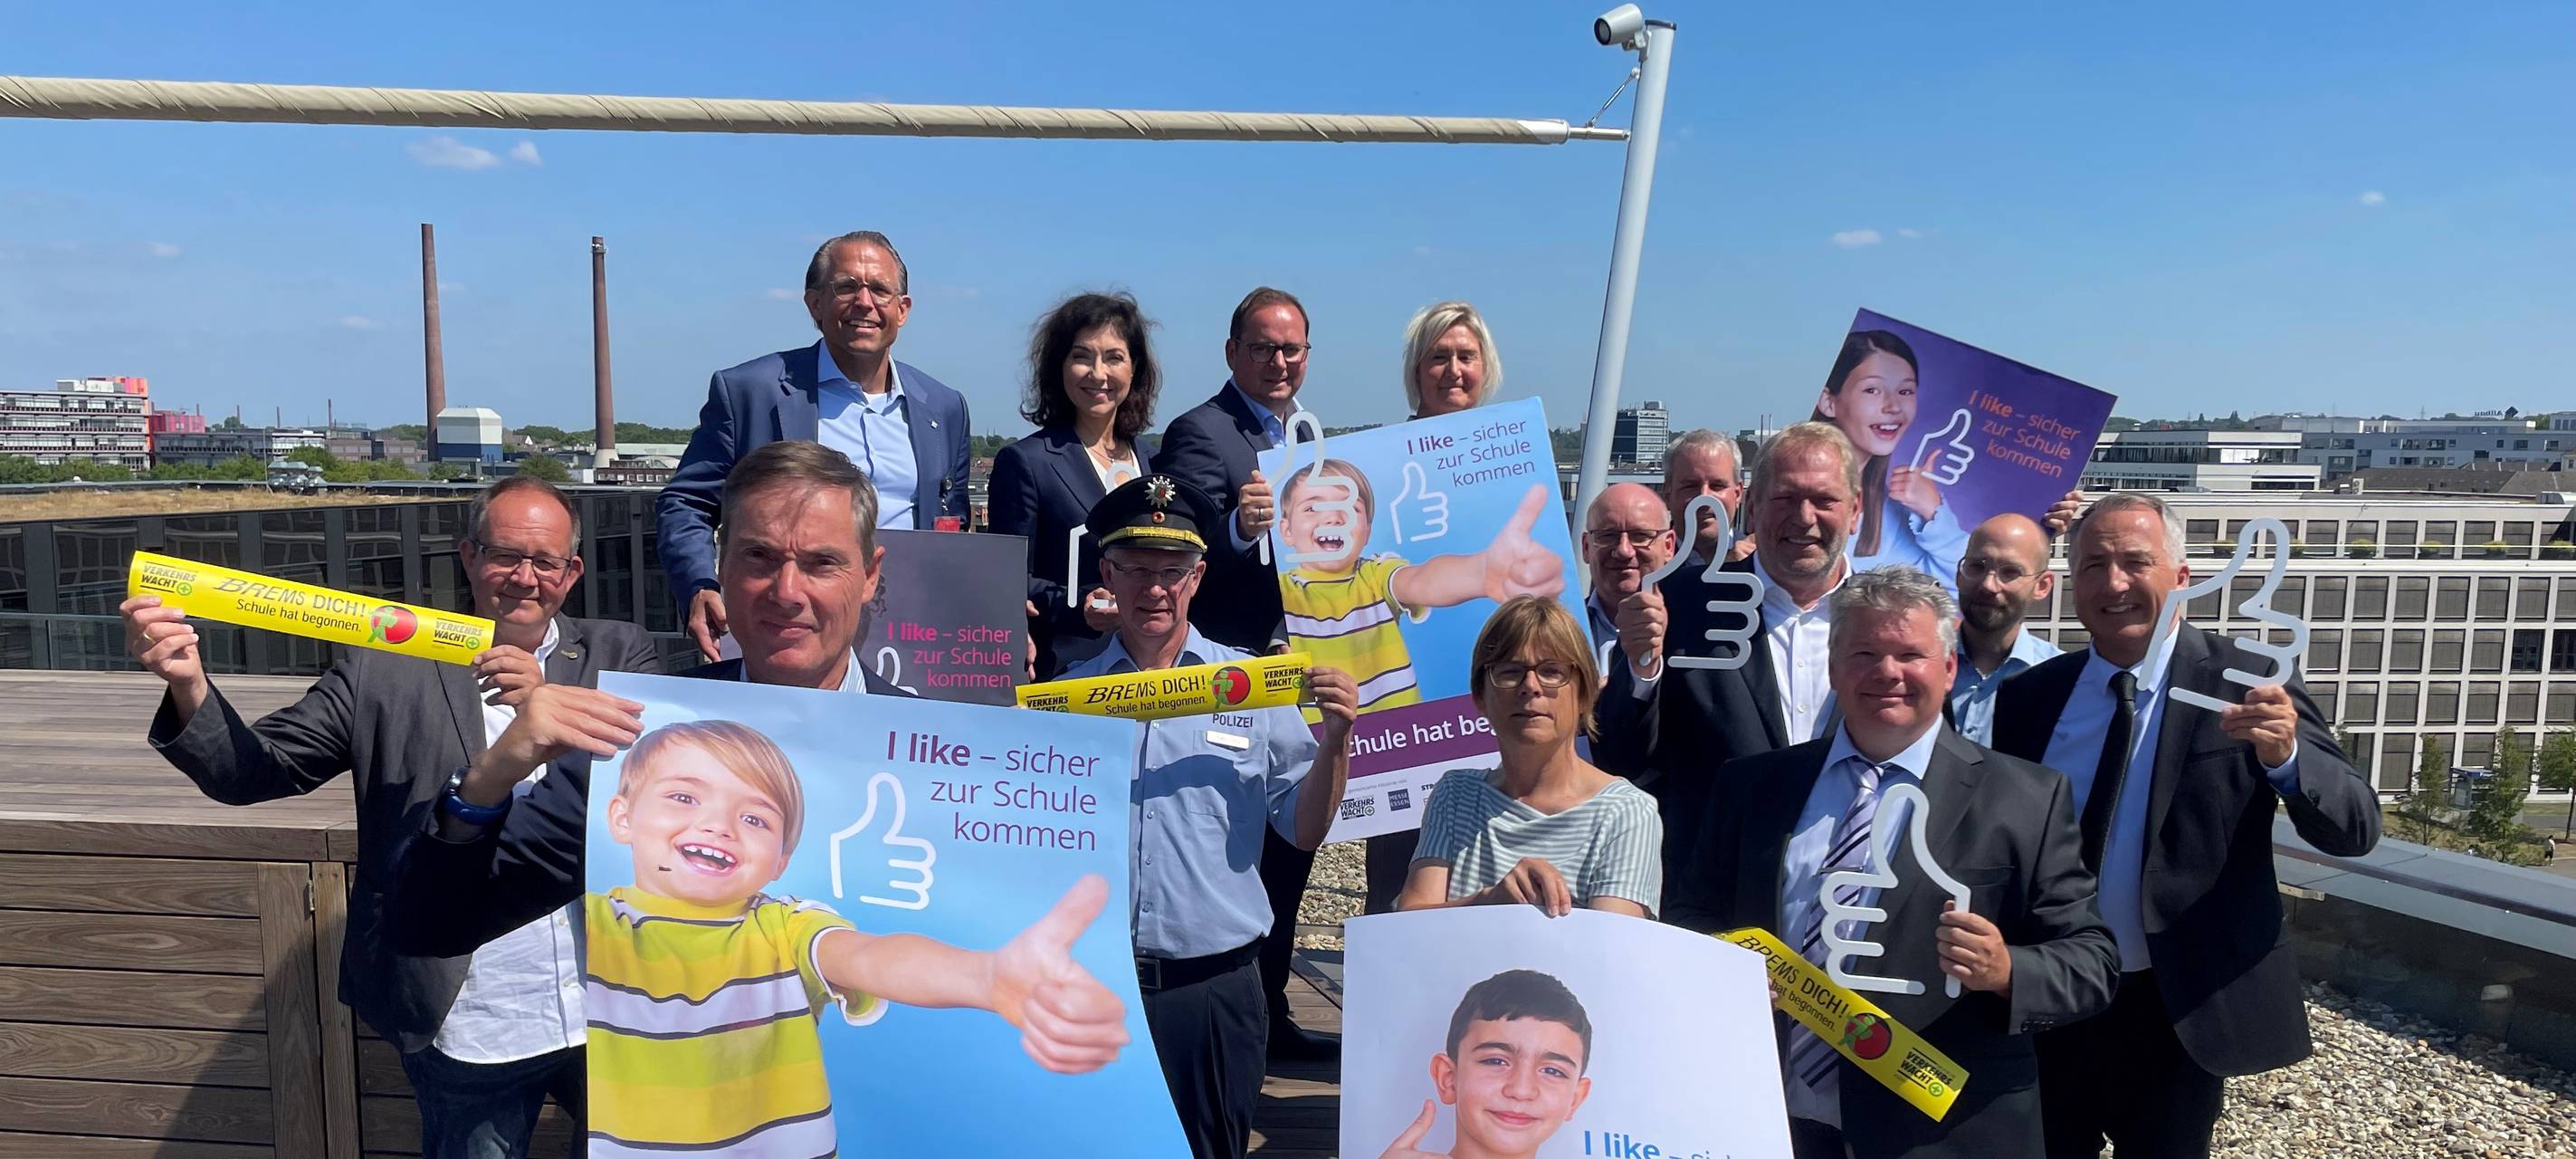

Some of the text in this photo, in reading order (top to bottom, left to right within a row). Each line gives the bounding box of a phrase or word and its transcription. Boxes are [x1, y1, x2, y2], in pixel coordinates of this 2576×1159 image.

[1969, 390, 1979, 405] I
[1980, 394, 2013, 417] like
[2027, 414, 2081, 441] sicher
[1407, 439, 1414, 455] I
[1419, 435, 1454, 452] like
[1473, 420, 1526, 442] sicher
[1982, 419, 2071, 460] zur Schule
[1436, 439, 1531, 470] zur Schule
[1986, 439, 2062, 478] kommen
[1453, 460, 1535, 487] kommen
[141, 574, 177, 588] WACHT
[144, 565, 196, 582] VERKEHRS
[213, 577, 366, 618] BREMS DICH!
[236, 599, 362, 632] Schule hat begonnen.
[435, 620, 483, 636] VERKEHRS
[434, 630, 467, 643] WACHT
[887, 622, 893, 639] I
[900, 623, 937, 641] like
[957, 625, 1012, 643] sicher
[913, 647, 1011, 666] zur Schule
[927, 669, 1011, 687] kommen
[1264, 666, 1303, 679] VERKEHRS
[1264, 678, 1292, 688] WACHT
[1026, 695, 1068, 708] VERKEHRS
[1083, 675, 1206, 704] BREMS DICH!
[1105, 696, 1207, 714] Schule hat begonnen.
[1212, 714, 1254, 728] POLIZEI
[1349, 715, 1496, 758] chule hat be
[887, 731, 896, 760] I
[909, 733, 971, 767] like
[1005, 744, 1101, 777] sicher
[930, 781, 1097, 815] zur Schule
[1340, 798, 1375, 810] VERKEHRS
[1388, 791, 1409, 801] MESSE
[1390, 799, 1411, 808] ESSEN
[1340, 806, 1365, 818] WACHT
[954, 811, 1096, 851] kommen
[1770, 979, 1836, 1032] hat begonnen.
[1800, 978, 1849, 1019] DICH!
[1901, 1059, 1934, 1085] WACHT
[1906, 1051, 1952, 1086] VERKEHRS
[1584, 1130, 1591, 1155] I
[1604, 1131, 1661, 1159] like
